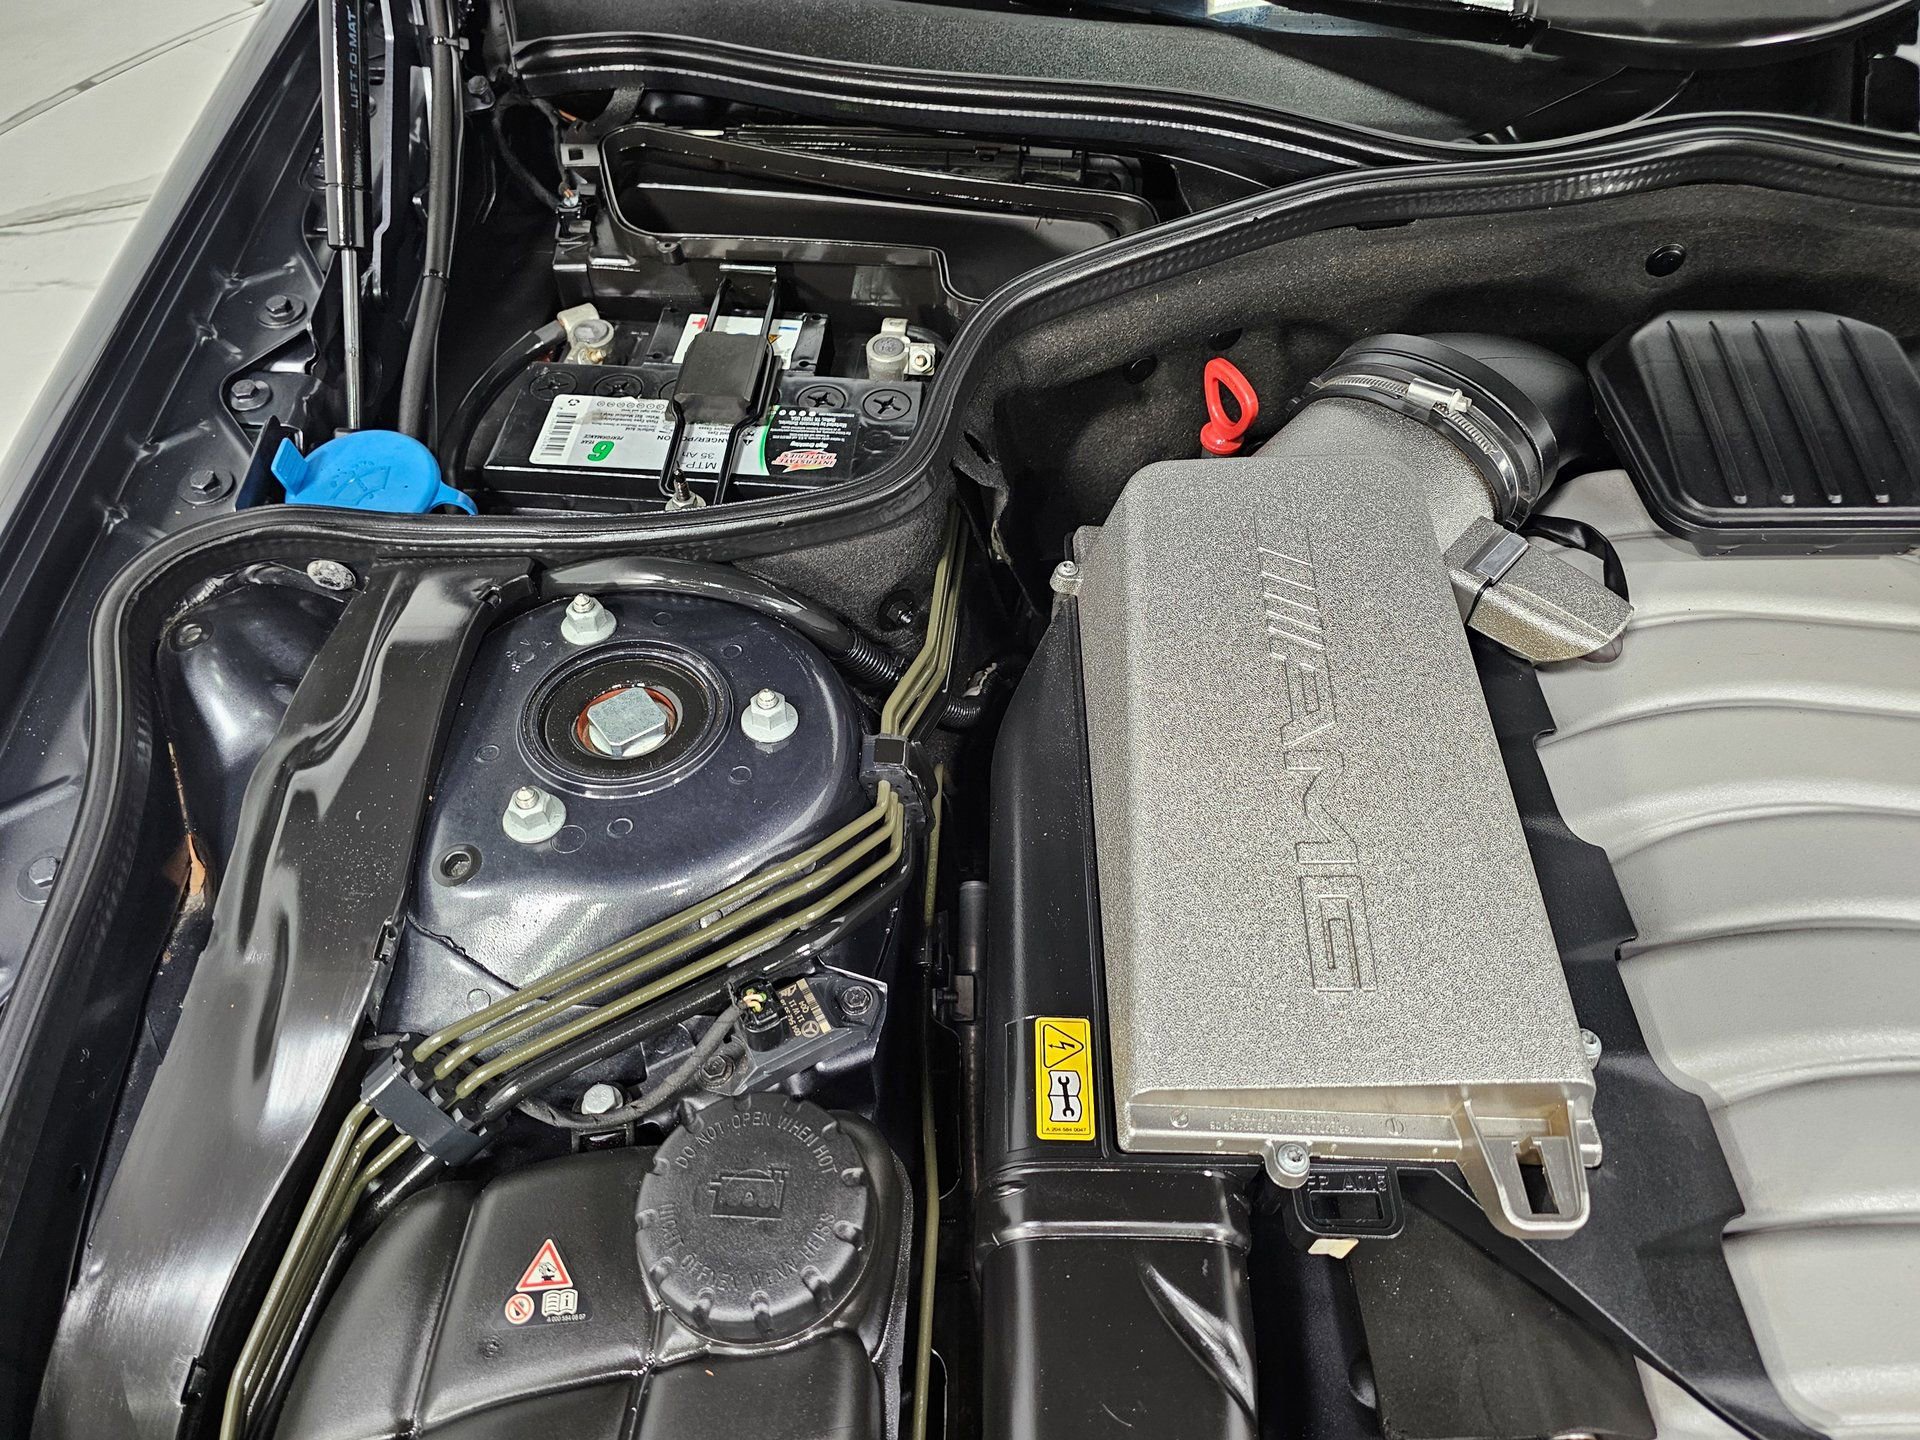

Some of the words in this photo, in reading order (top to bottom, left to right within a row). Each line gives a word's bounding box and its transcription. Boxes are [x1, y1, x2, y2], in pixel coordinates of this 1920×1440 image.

[587, 440, 615, 462] 6
[675, 1145, 697, 1170] DO
[695, 1121, 725, 1148] NOT
[731, 1111, 771, 1130] OPEN
[777, 1114, 820, 1148] WHEN
[812, 1144, 839, 1174] HOT
[800, 1211, 836, 1264] HEISS
